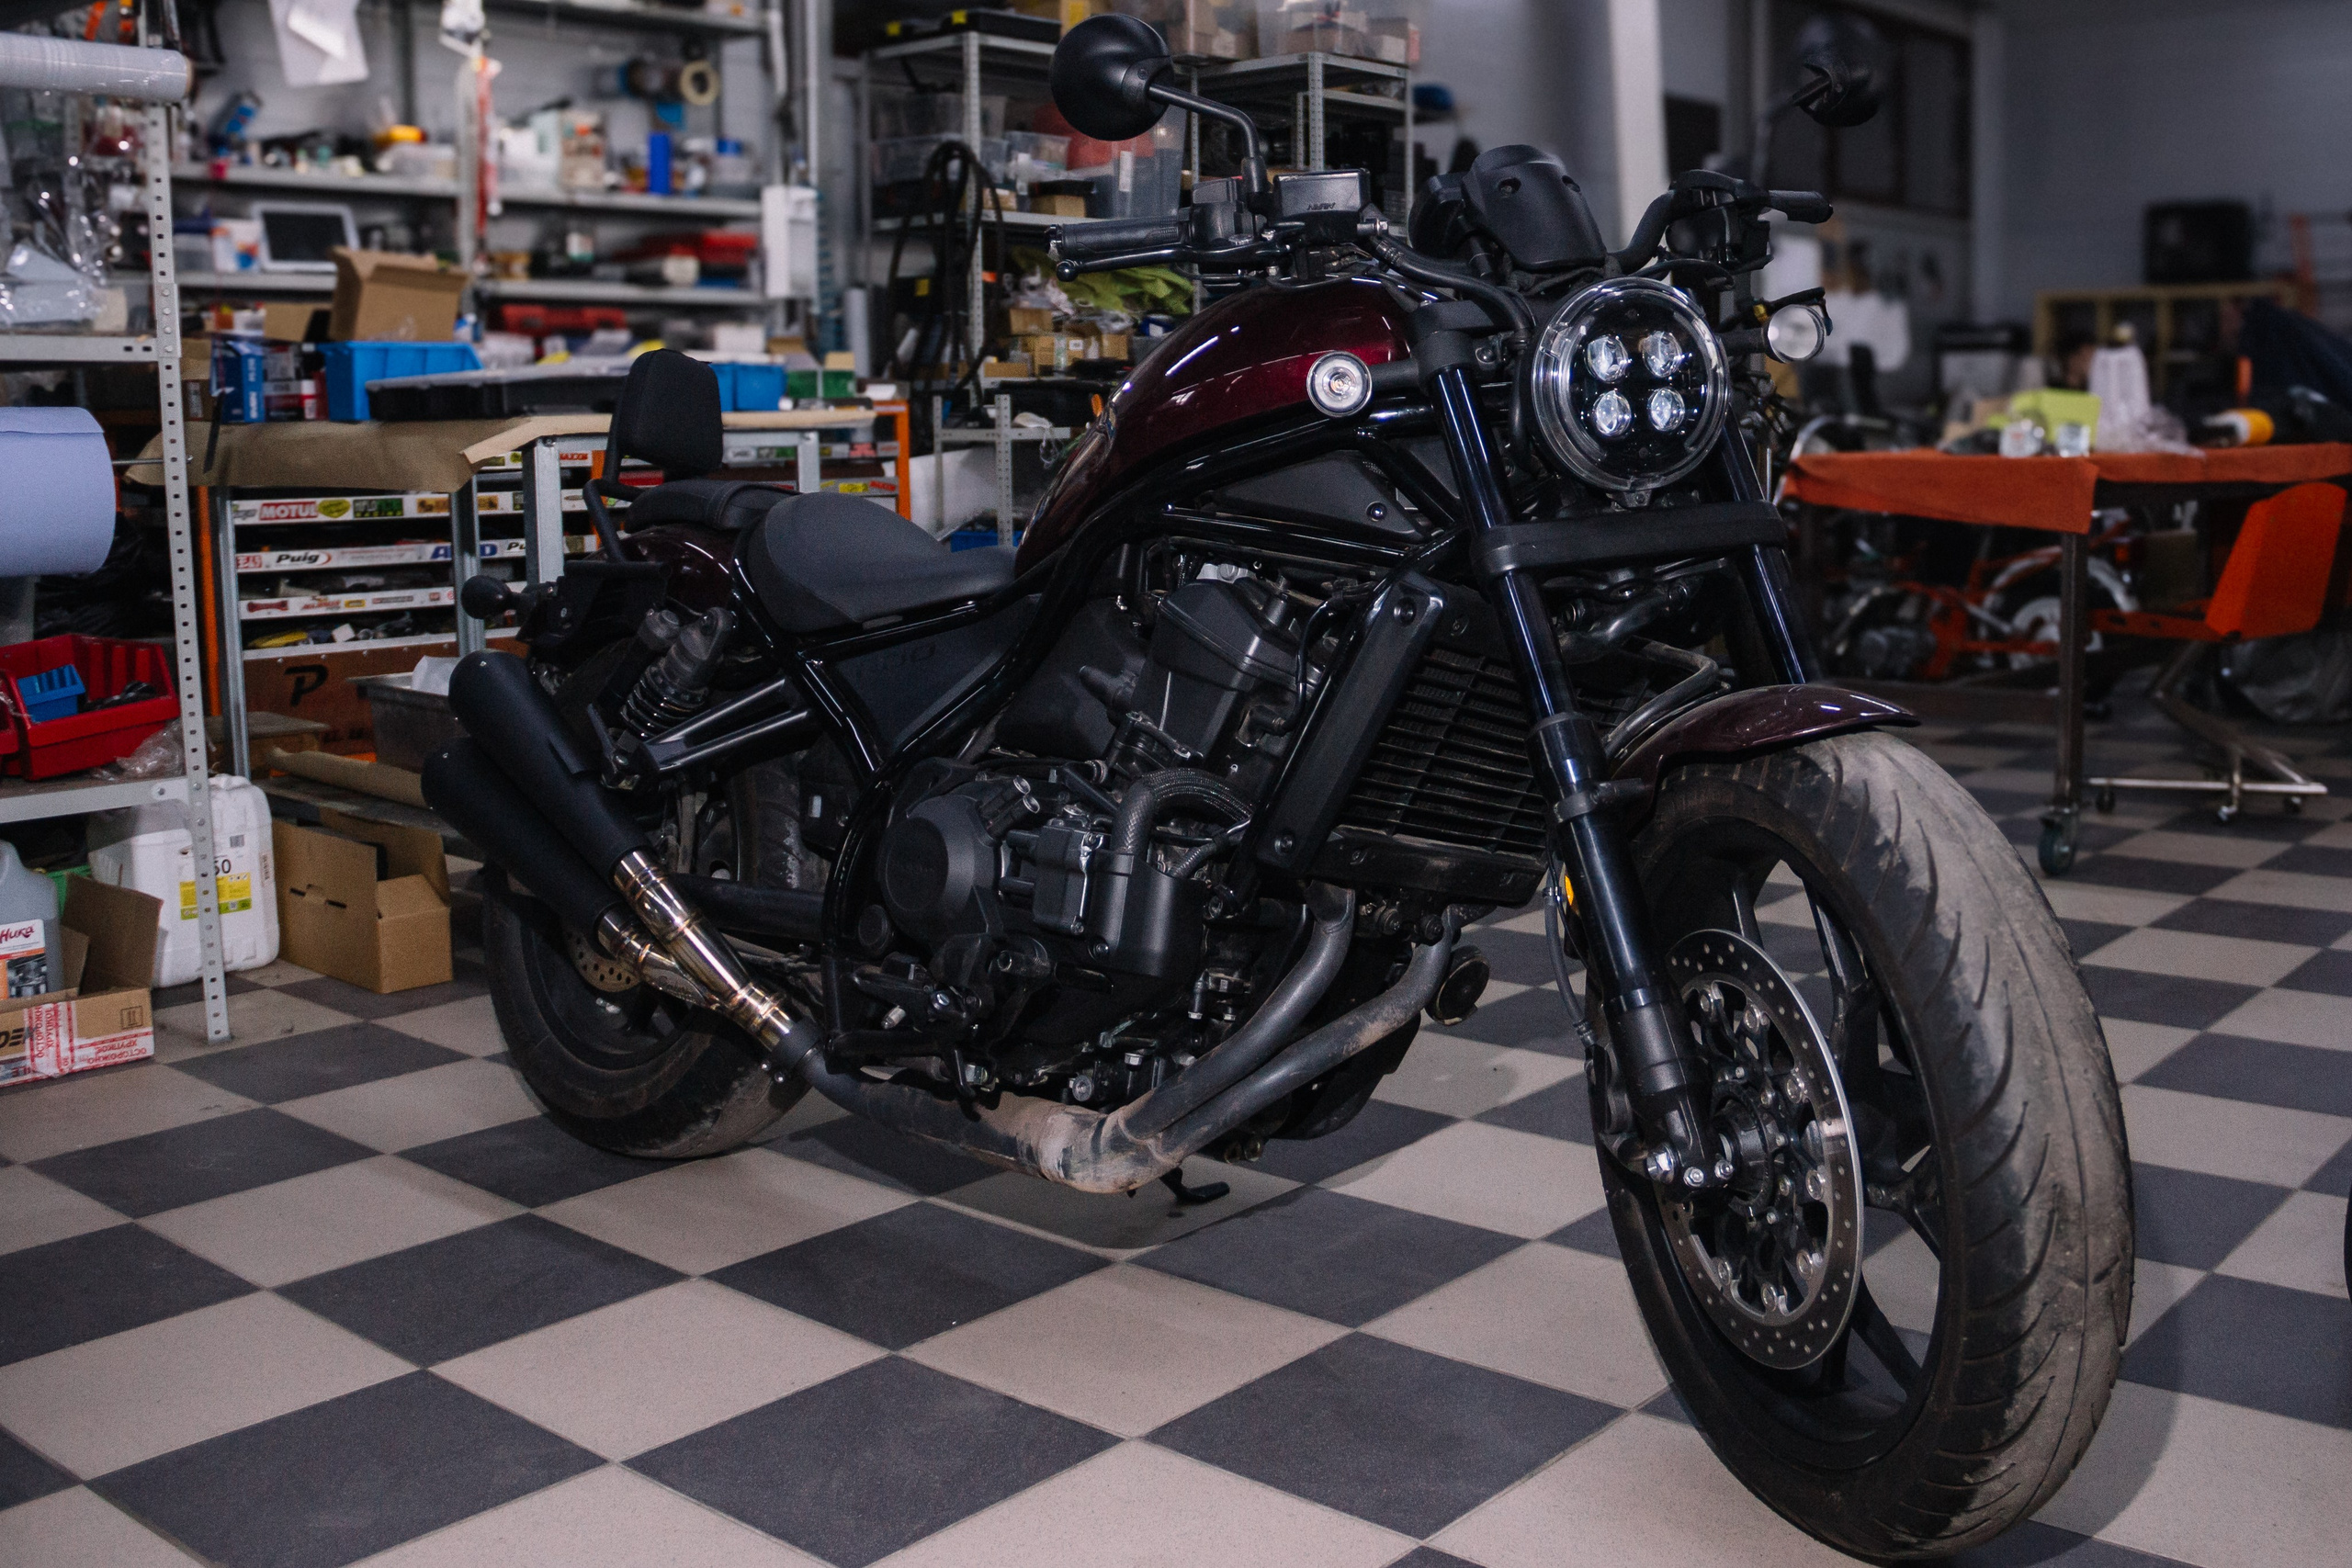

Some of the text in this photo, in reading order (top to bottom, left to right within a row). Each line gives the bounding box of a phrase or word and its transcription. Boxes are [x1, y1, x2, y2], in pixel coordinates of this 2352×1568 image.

[263, 504, 318, 519] MOTUL
[277, 552, 320, 564] Puig
[35, 1006, 44, 1057] ОСТОРОЖН
